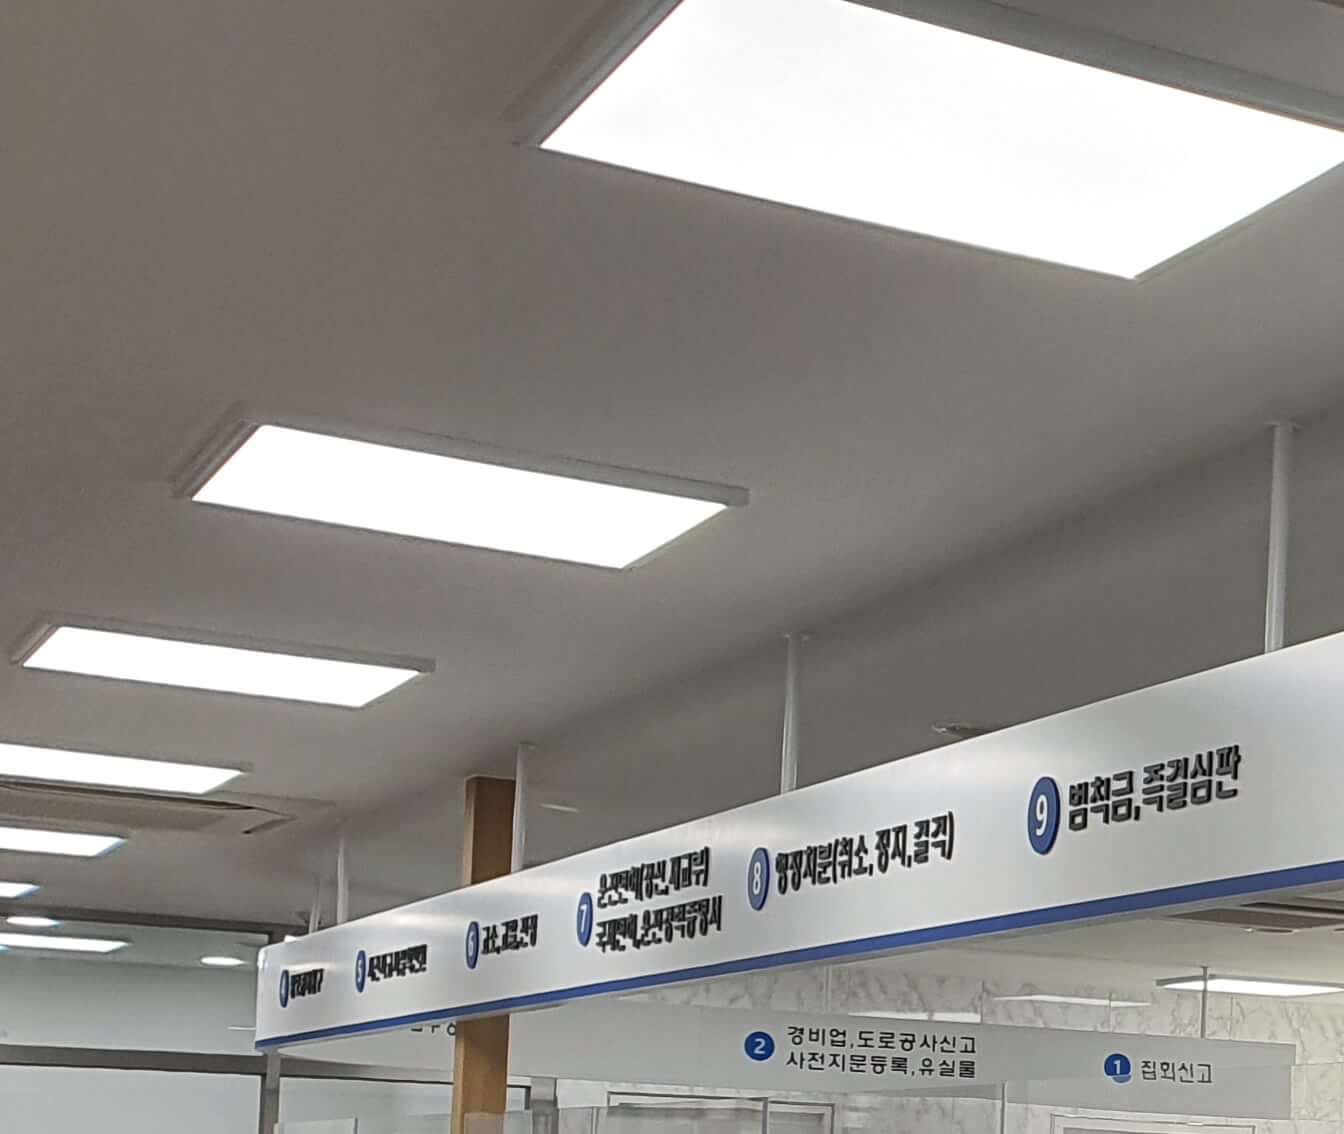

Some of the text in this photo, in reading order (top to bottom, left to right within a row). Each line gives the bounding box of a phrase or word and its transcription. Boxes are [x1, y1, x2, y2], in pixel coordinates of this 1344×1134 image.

[1068, 744, 1242, 832] 범칙금,즉결심판
[752, 1025, 977, 1054] 2 경비업,도로공사신고
[785, 1051, 977, 1079] 사전지문등록,유실물
[1141, 1060, 1213, 1083] 집회신고
